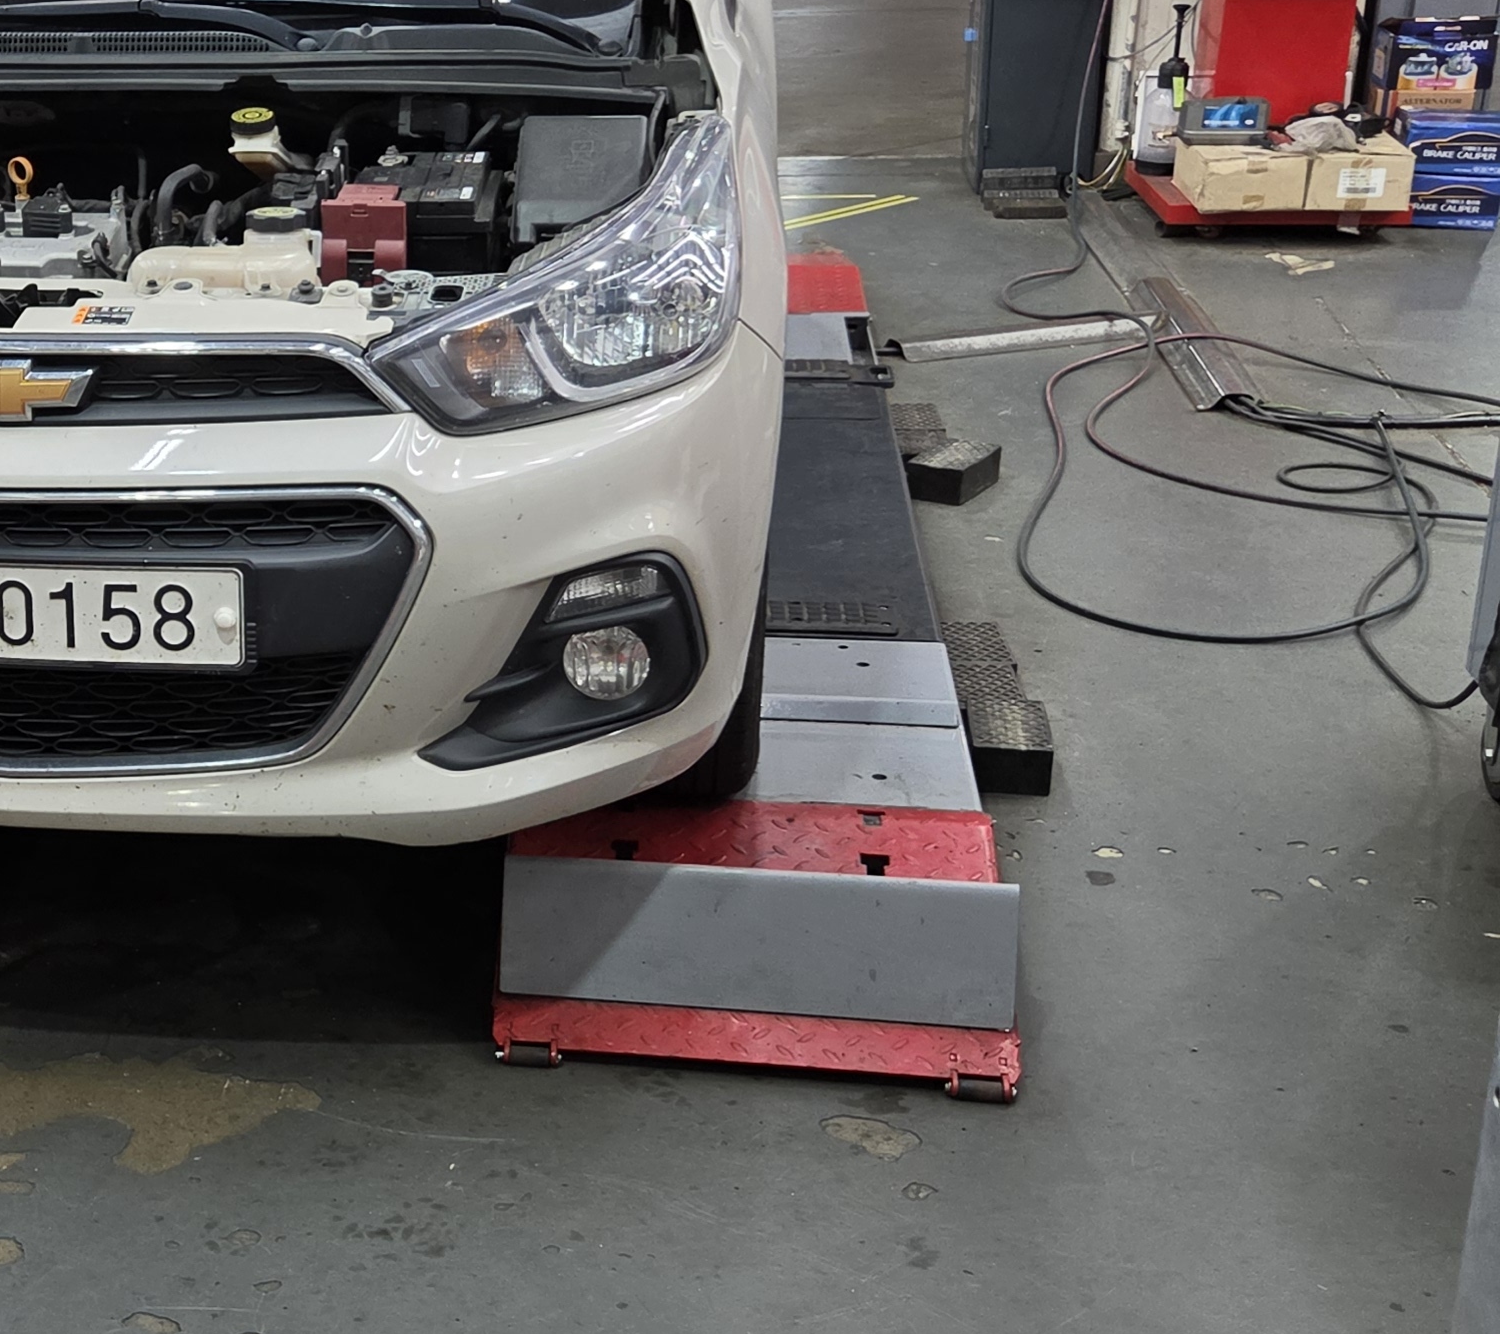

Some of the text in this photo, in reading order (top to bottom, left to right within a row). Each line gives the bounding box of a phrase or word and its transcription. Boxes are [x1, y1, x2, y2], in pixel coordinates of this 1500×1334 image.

[1422, 148, 1455, 160] BRAKE
[1411, 201, 1439, 213] RAKE
[1440, 202, 1481, 214] CALIPER
